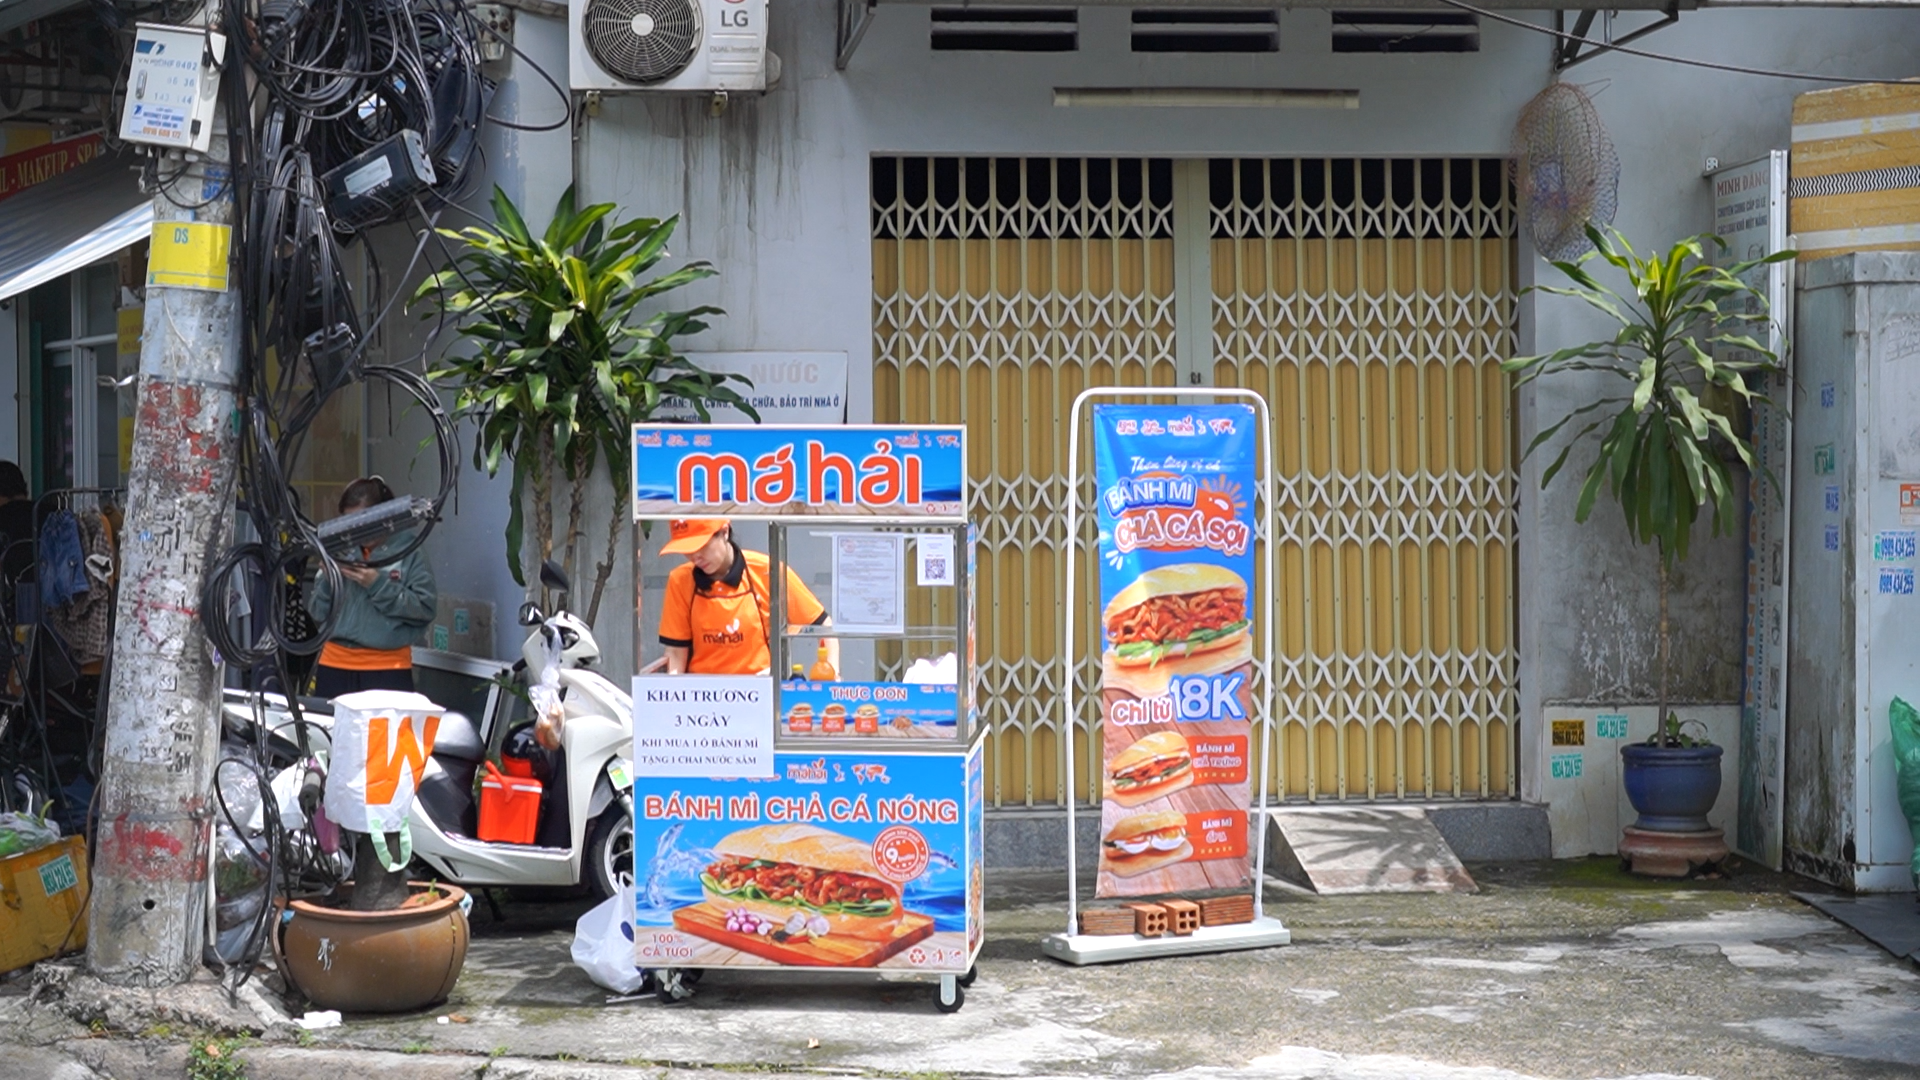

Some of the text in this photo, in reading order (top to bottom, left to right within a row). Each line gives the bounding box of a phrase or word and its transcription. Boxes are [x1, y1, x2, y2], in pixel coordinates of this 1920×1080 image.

[720, 10, 749, 27] LG
[17, 150, 68, 189] MAKEUP
[1717, 177, 1741, 197] MINH
[174, 228, 189, 245] DS
[750, 359, 819, 384] NƯỚC
[780, 393, 797, 408] BẢO
[800, 395, 812, 408] TRÌ
[814, 395, 831, 408] NHÀ
[1107, 477, 1193, 511] BÁNH MÌ
[1116, 511, 1163, 548] CHẢ
[1166, 510, 1205, 542] CÁ
[646, 689, 759, 703] KHAI TRƯƠNG
[829, 685, 870, 702] THỰC
[873, 685, 908, 701] ĐƠN
[1170, 677, 1242, 719] 18K
[674, 712, 731, 727] 3 NGÀY
[1112, 697, 1173, 726] Chỉ từ
[641, 739, 661, 748] KHI
[665, 739, 689, 748] MUA
[711, 737, 741, 748] BÁNH
[745, 737, 758, 748] MÌ
[642, 755, 669, 765] TẶNG
[678, 756, 702, 764] CHAI
[705, 755, 733, 764] NƯỚC
[645, 791, 958, 823] BÁNH MÌ CHẢ CÁ NÓNG
[885, 847, 899, 864] 9
[651, 933, 684, 944] 100%
